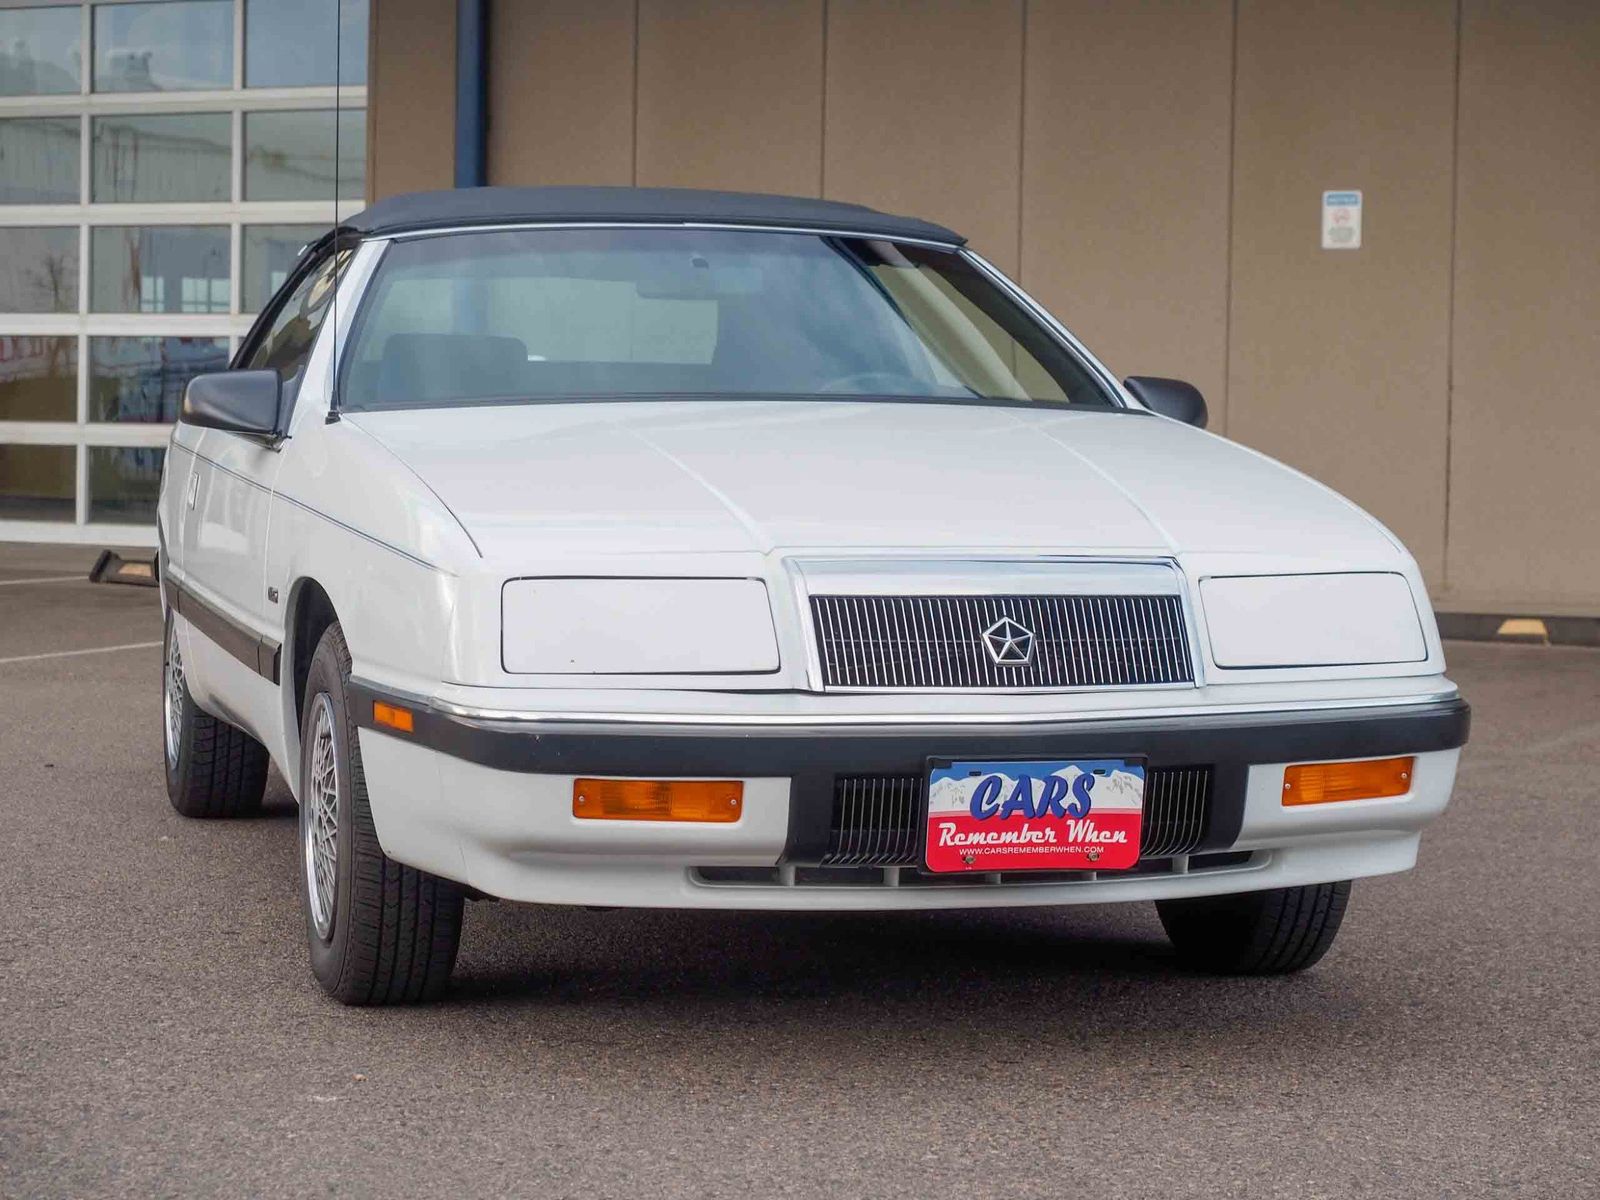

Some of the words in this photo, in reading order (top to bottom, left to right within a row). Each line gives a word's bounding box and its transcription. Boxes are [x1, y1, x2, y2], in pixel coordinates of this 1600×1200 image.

[969, 773, 1095, 821] CARS
[938, 822, 1057, 847] Remember
[1066, 819, 1128, 843] When
[959, 846, 1104, 855] WWW.CARSREMEMBERWHEN.COM
